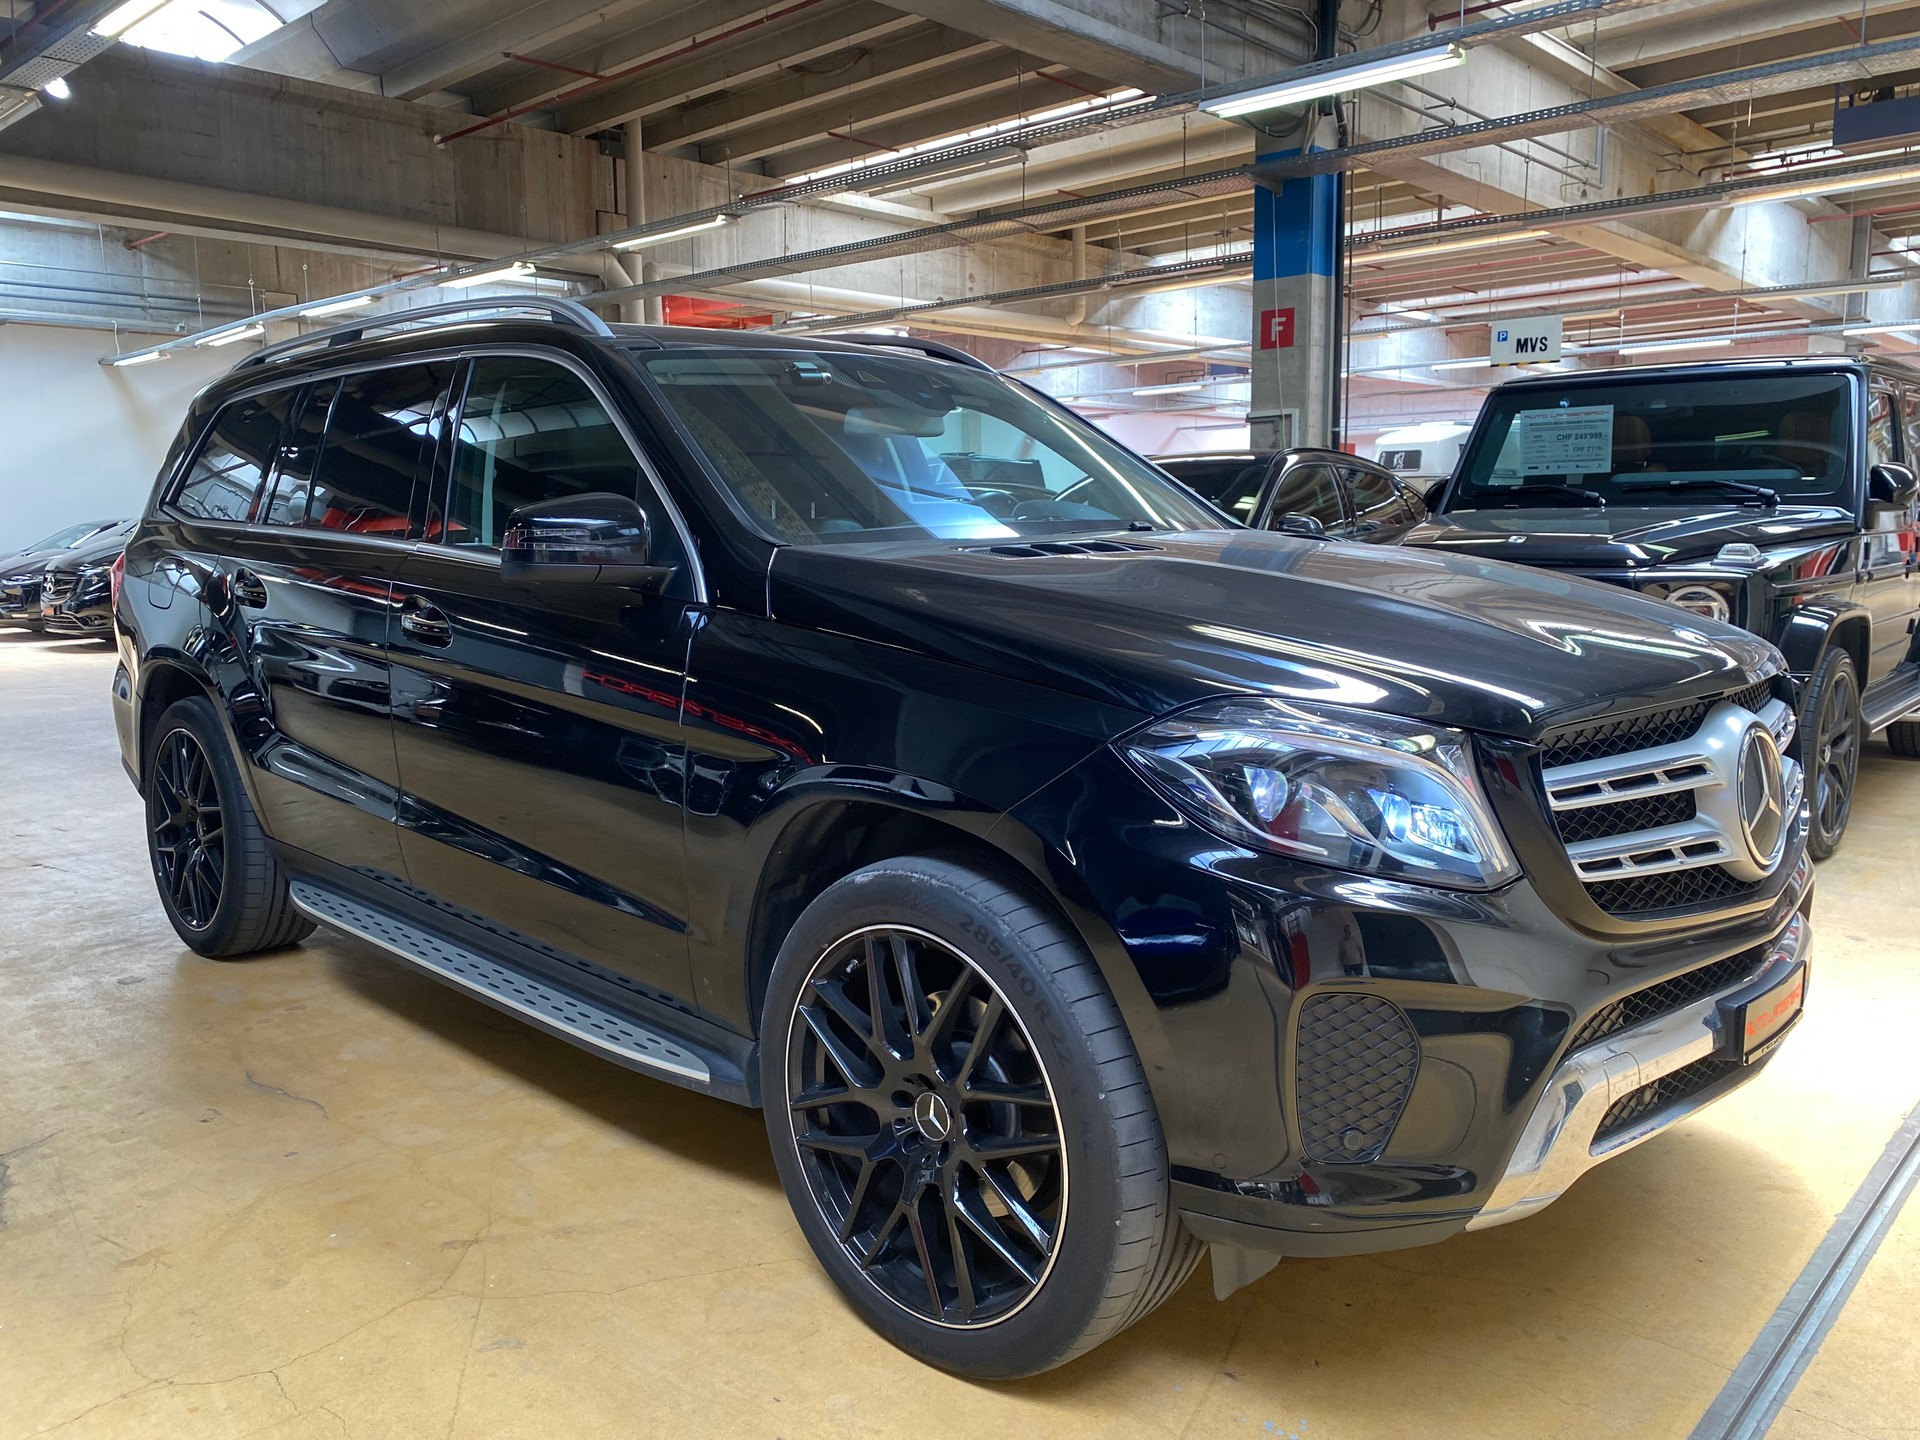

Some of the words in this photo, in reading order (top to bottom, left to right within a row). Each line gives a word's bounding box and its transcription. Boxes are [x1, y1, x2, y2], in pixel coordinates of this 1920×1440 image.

[1271, 317, 1286, 341] F
[1515, 336, 1548, 354] MVS
[1556, 433, 1572, 441] CHF
[959, 912, 1036, 997] 285/40
[1033, 999, 1050, 1024] R
